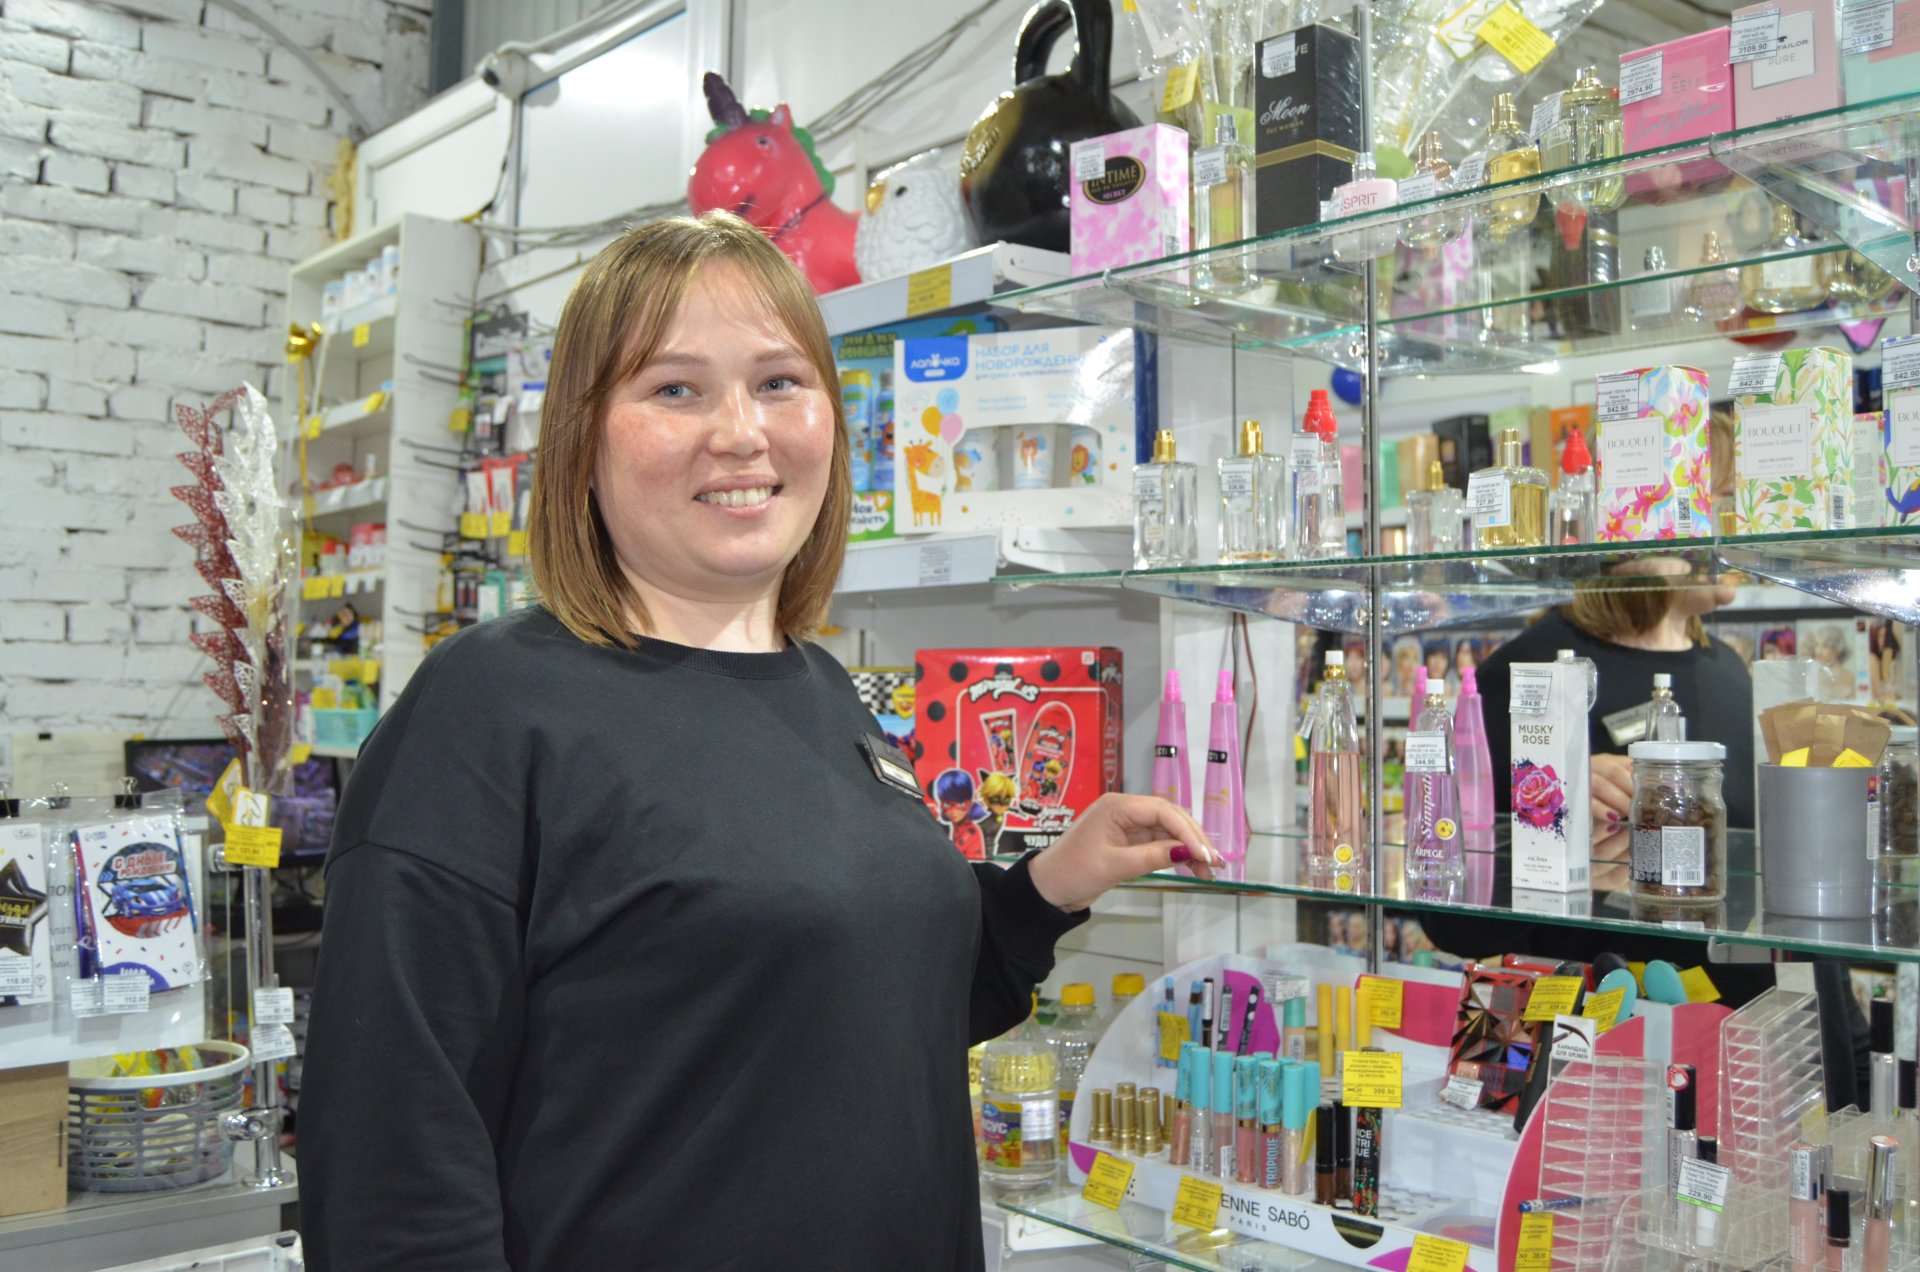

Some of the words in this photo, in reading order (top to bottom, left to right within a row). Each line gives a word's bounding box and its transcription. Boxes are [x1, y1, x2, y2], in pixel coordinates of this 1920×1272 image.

[1738, 43, 1768, 54] 3109.90
[1777, 39, 1808, 51] TAILOR
[1768, 53, 1797, 67] PURE
[1627, 83, 1653, 97] 2974.90
[1260, 95, 1311, 125] Moon
[1343, 192, 1378, 210] SPRIT
[975, 345, 1020, 357] НАБОР
[1023, 343, 1049, 356] ДЛЯ
[975, 355, 1085, 370] НОВОРОЖДЕНН
[1894, 370, 1920, 380] 842.90
[1748, 423, 1802, 438] BOUQUET
[1607, 436, 1655, 449] BOUQUET
[1519, 725, 1554, 735] MUSKY
[1522, 735, 1550, 745] ROSE
[1023, 834, 1049, 847] ЧУДО
[1557, 1044, 1587, 1053] КАРАНДАШ
[983, 1119, 1009, 1134] СУС
[1357, 1148, 1370, 1158] UE
[1266, 1137, 1279, 1187] TROPIQUE
[1688, 1189, 1712, 1201] 229.90
[1230, 1215, 1267, 1232] PARIS
[1267, 1206, 1310, 1231] SABÓ
